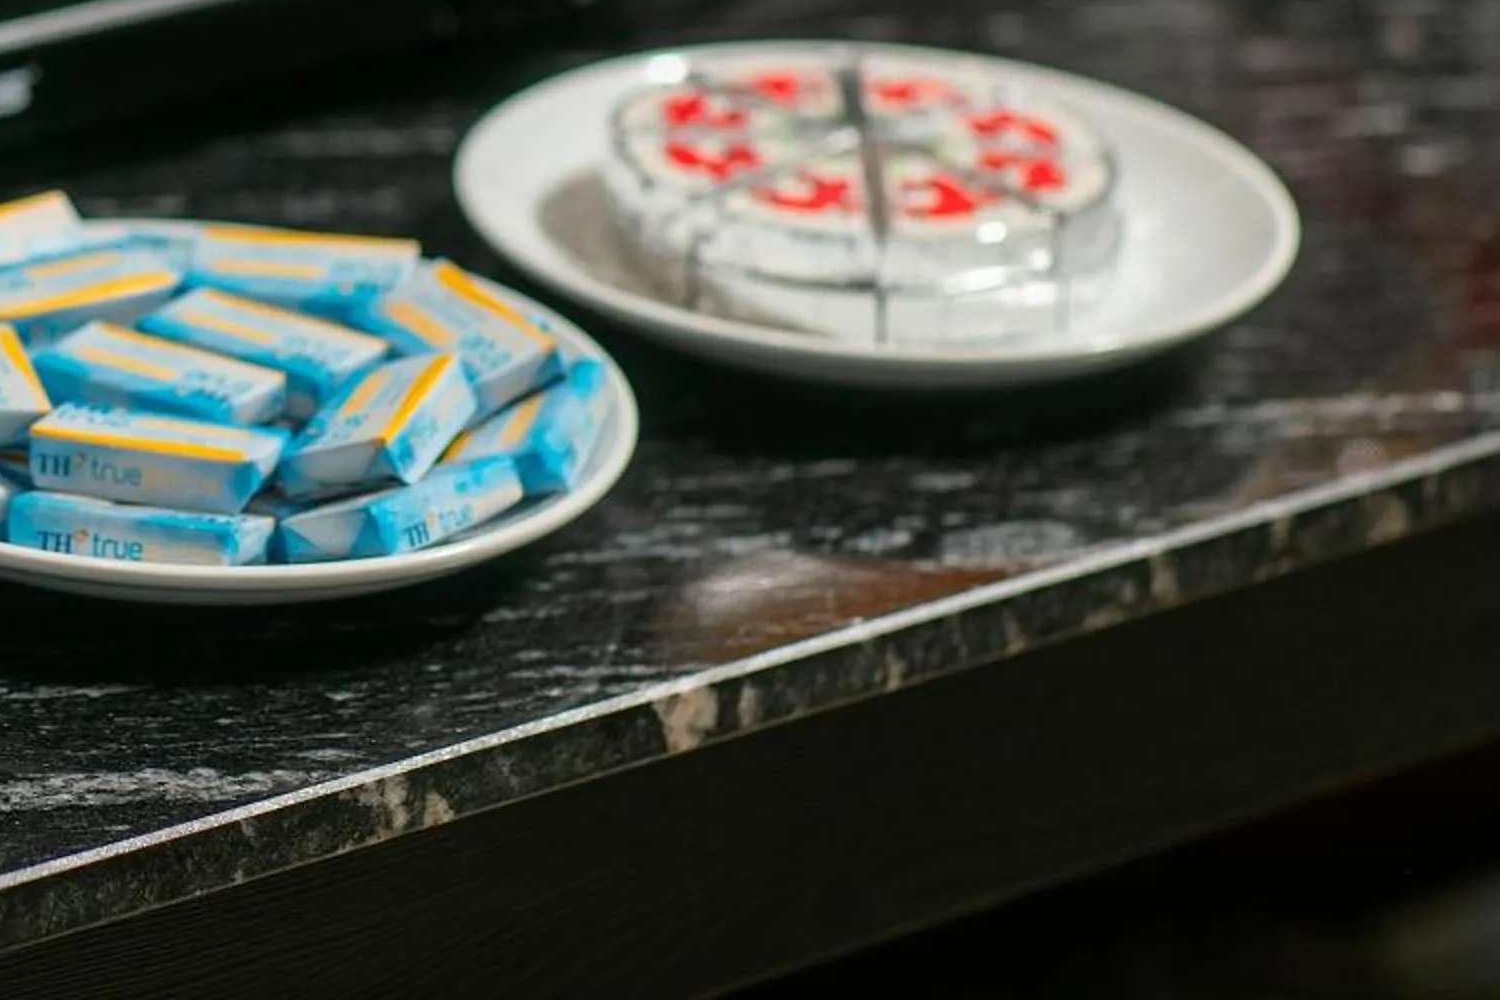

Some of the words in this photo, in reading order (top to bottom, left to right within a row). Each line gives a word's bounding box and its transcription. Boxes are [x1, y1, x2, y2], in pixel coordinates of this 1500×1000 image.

[36, 451, 72, 477] TH
[91, 456, 143, 487] true
[36, 529, 73, 554] TH
[91, 532, 144, 561] true
